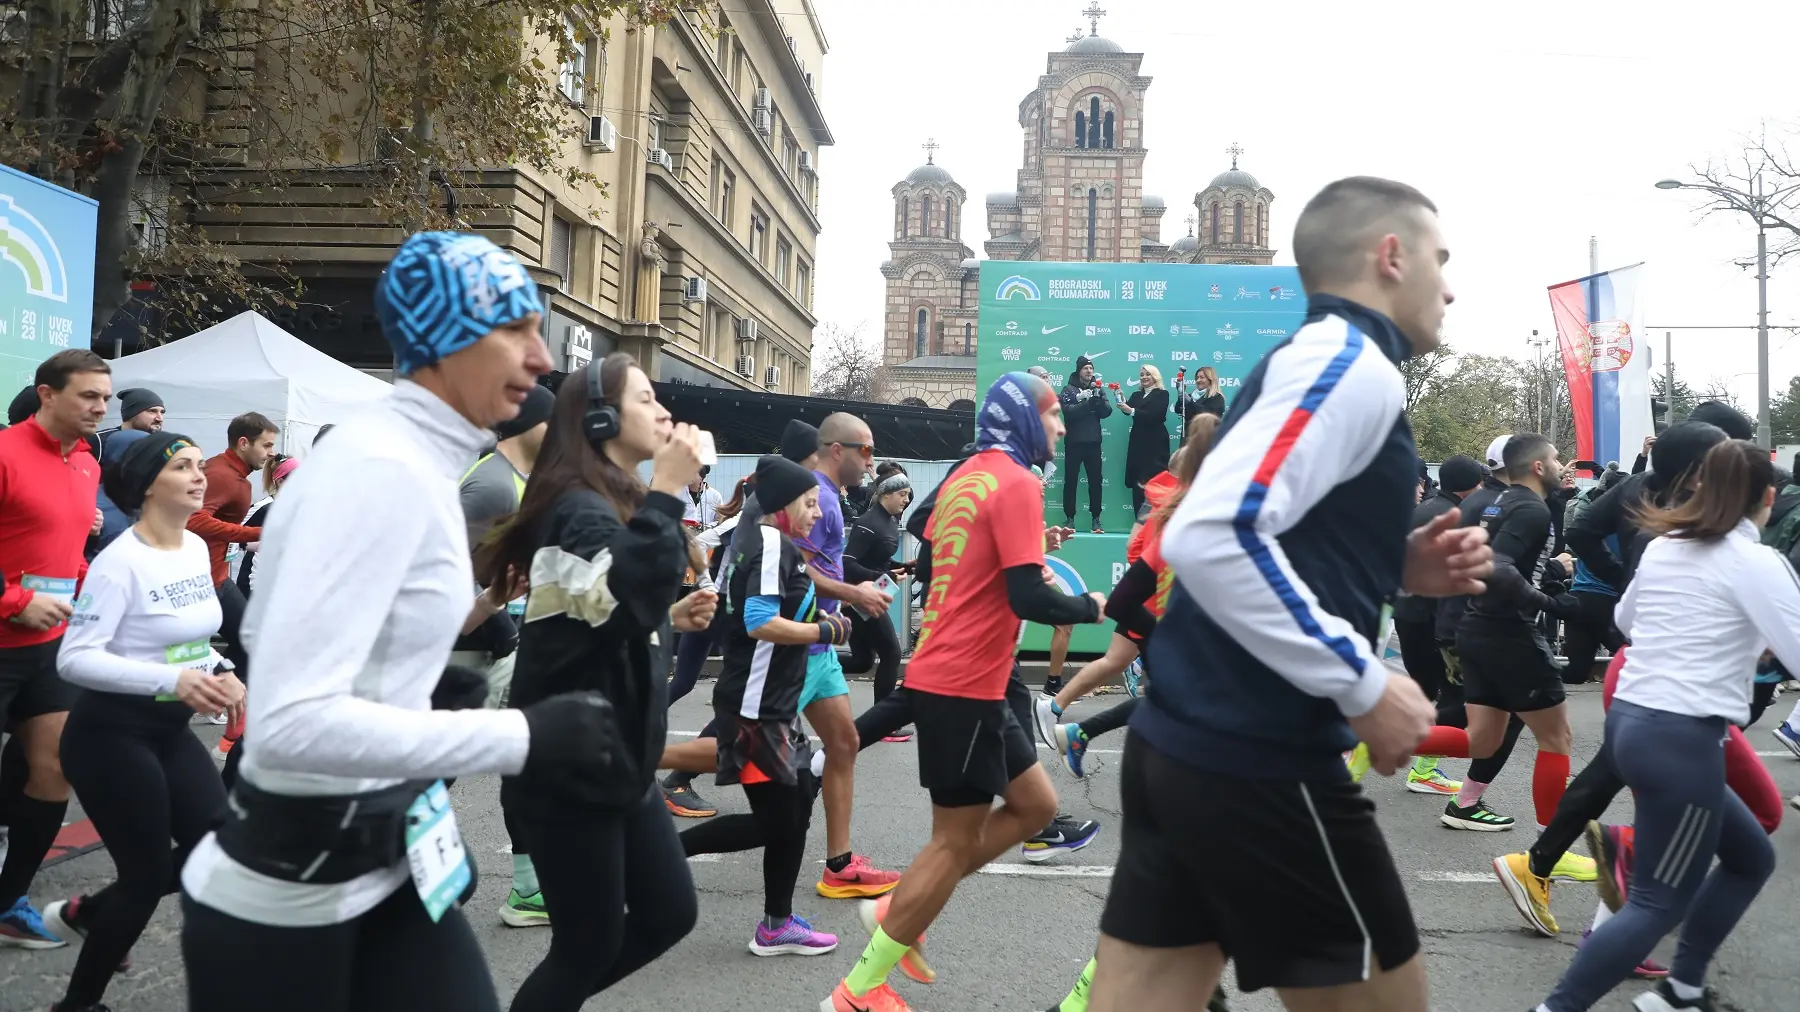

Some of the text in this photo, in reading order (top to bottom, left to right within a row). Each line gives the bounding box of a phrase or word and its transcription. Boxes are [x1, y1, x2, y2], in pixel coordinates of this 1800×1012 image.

[1049, 279, 1102, 290] BEOGRADSKI
[1121, 280, 1134, 290] 20
[1145, 280, 1167, 291] UVEK
[1048, 289, 1110, 300] POLUMARATON
[1121, 290, 1134, 300] 23
[22, 309, 36, 325] 20
[49, 315, 72, 334] UVEK
[21, 324, 36, 340] 23
[1218, 378, 1240, 387] DEA
